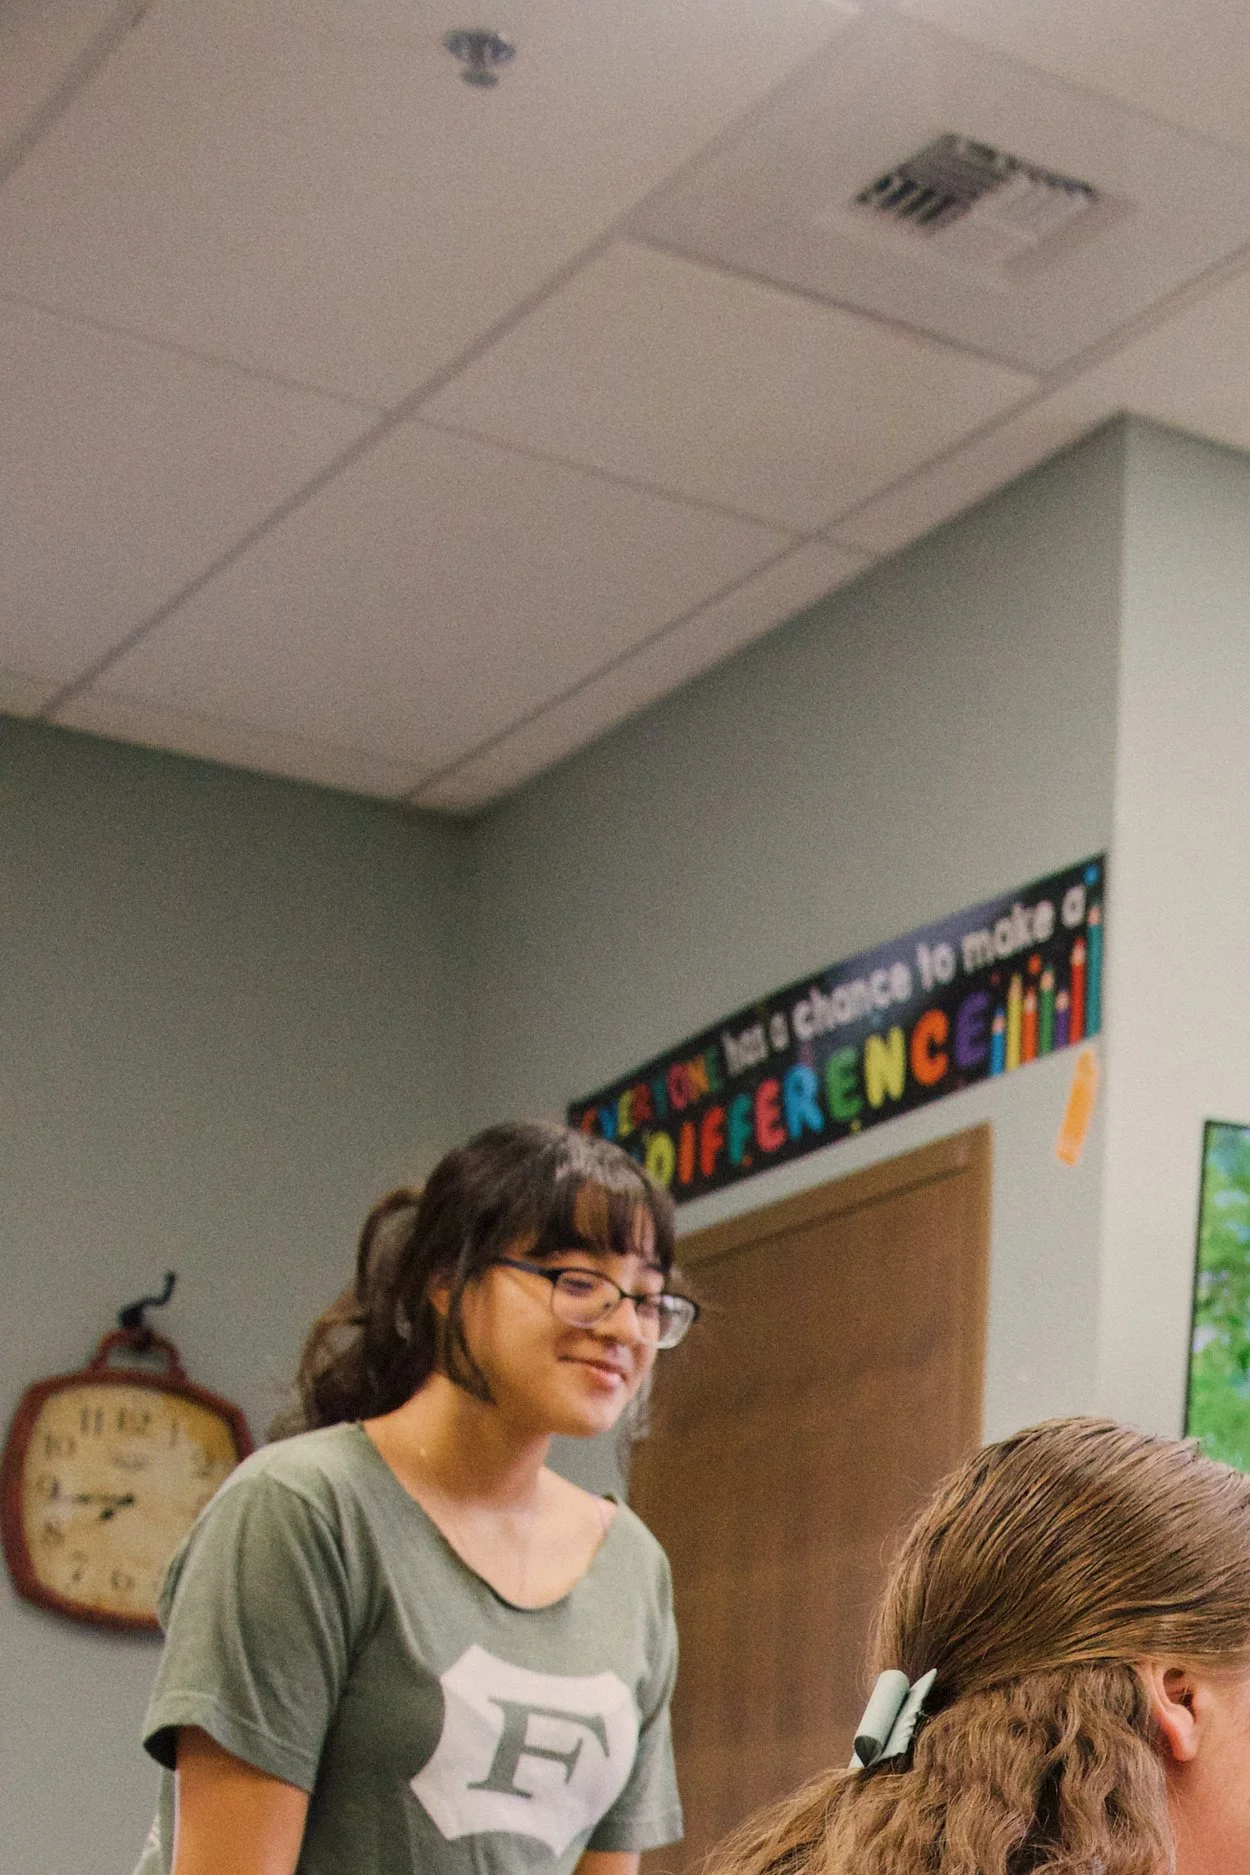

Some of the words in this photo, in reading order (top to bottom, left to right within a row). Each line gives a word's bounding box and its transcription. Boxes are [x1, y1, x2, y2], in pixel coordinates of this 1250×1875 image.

[721, 1022, 768, 1076] has
[769, 1012, 789, 1050] a
[792, 961, 911, 1039] chance
[916, 942, 955, 991] to
[962, 899, 1054, 972] make
[1062, 886, 1086, 927] a
[645, 990, 990, 1191] DIFFERENCE
[466, 1695, 611, 1800] F
